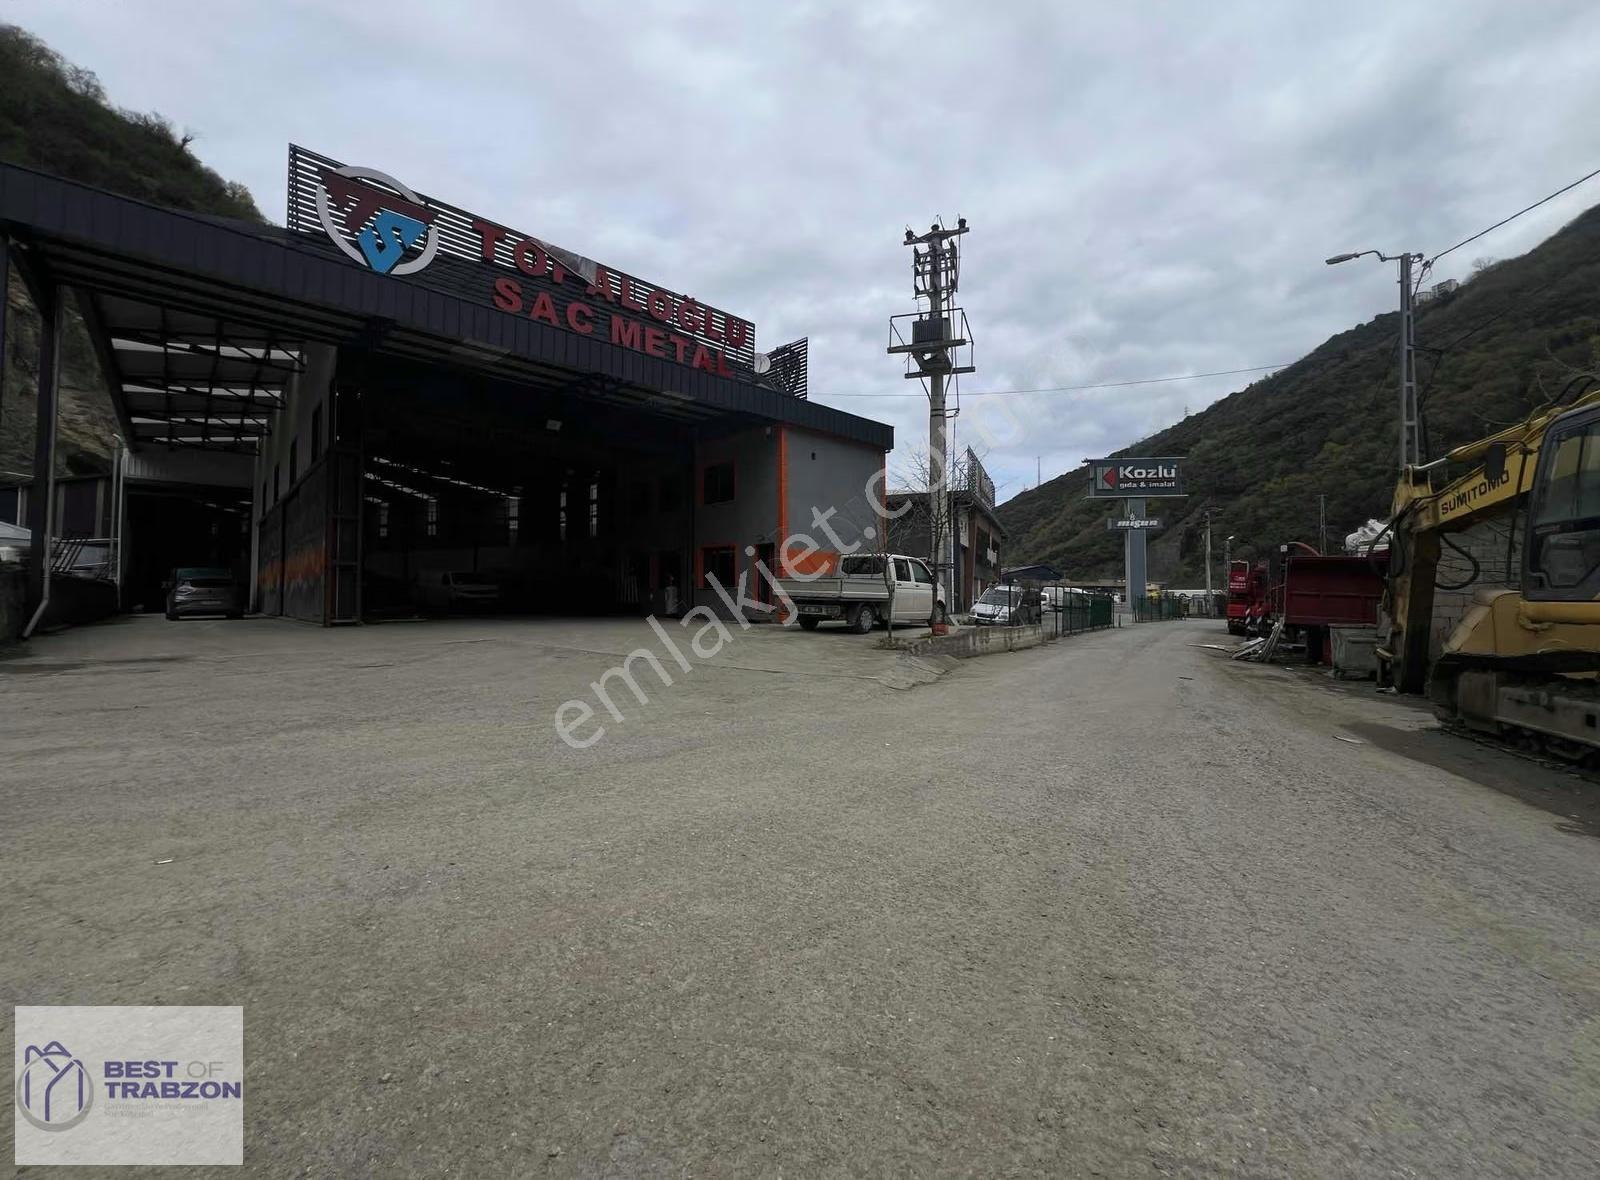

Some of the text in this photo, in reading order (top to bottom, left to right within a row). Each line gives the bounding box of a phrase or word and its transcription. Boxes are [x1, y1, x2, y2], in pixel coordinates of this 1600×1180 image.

[472, 218, 748, 348] TOALOĞLU
[494, 277, 736, 378] SAC METAL
[1119, 465, 1176, 479] Kozlu
[1441, 470, 1509, 515] SUMITOMO
